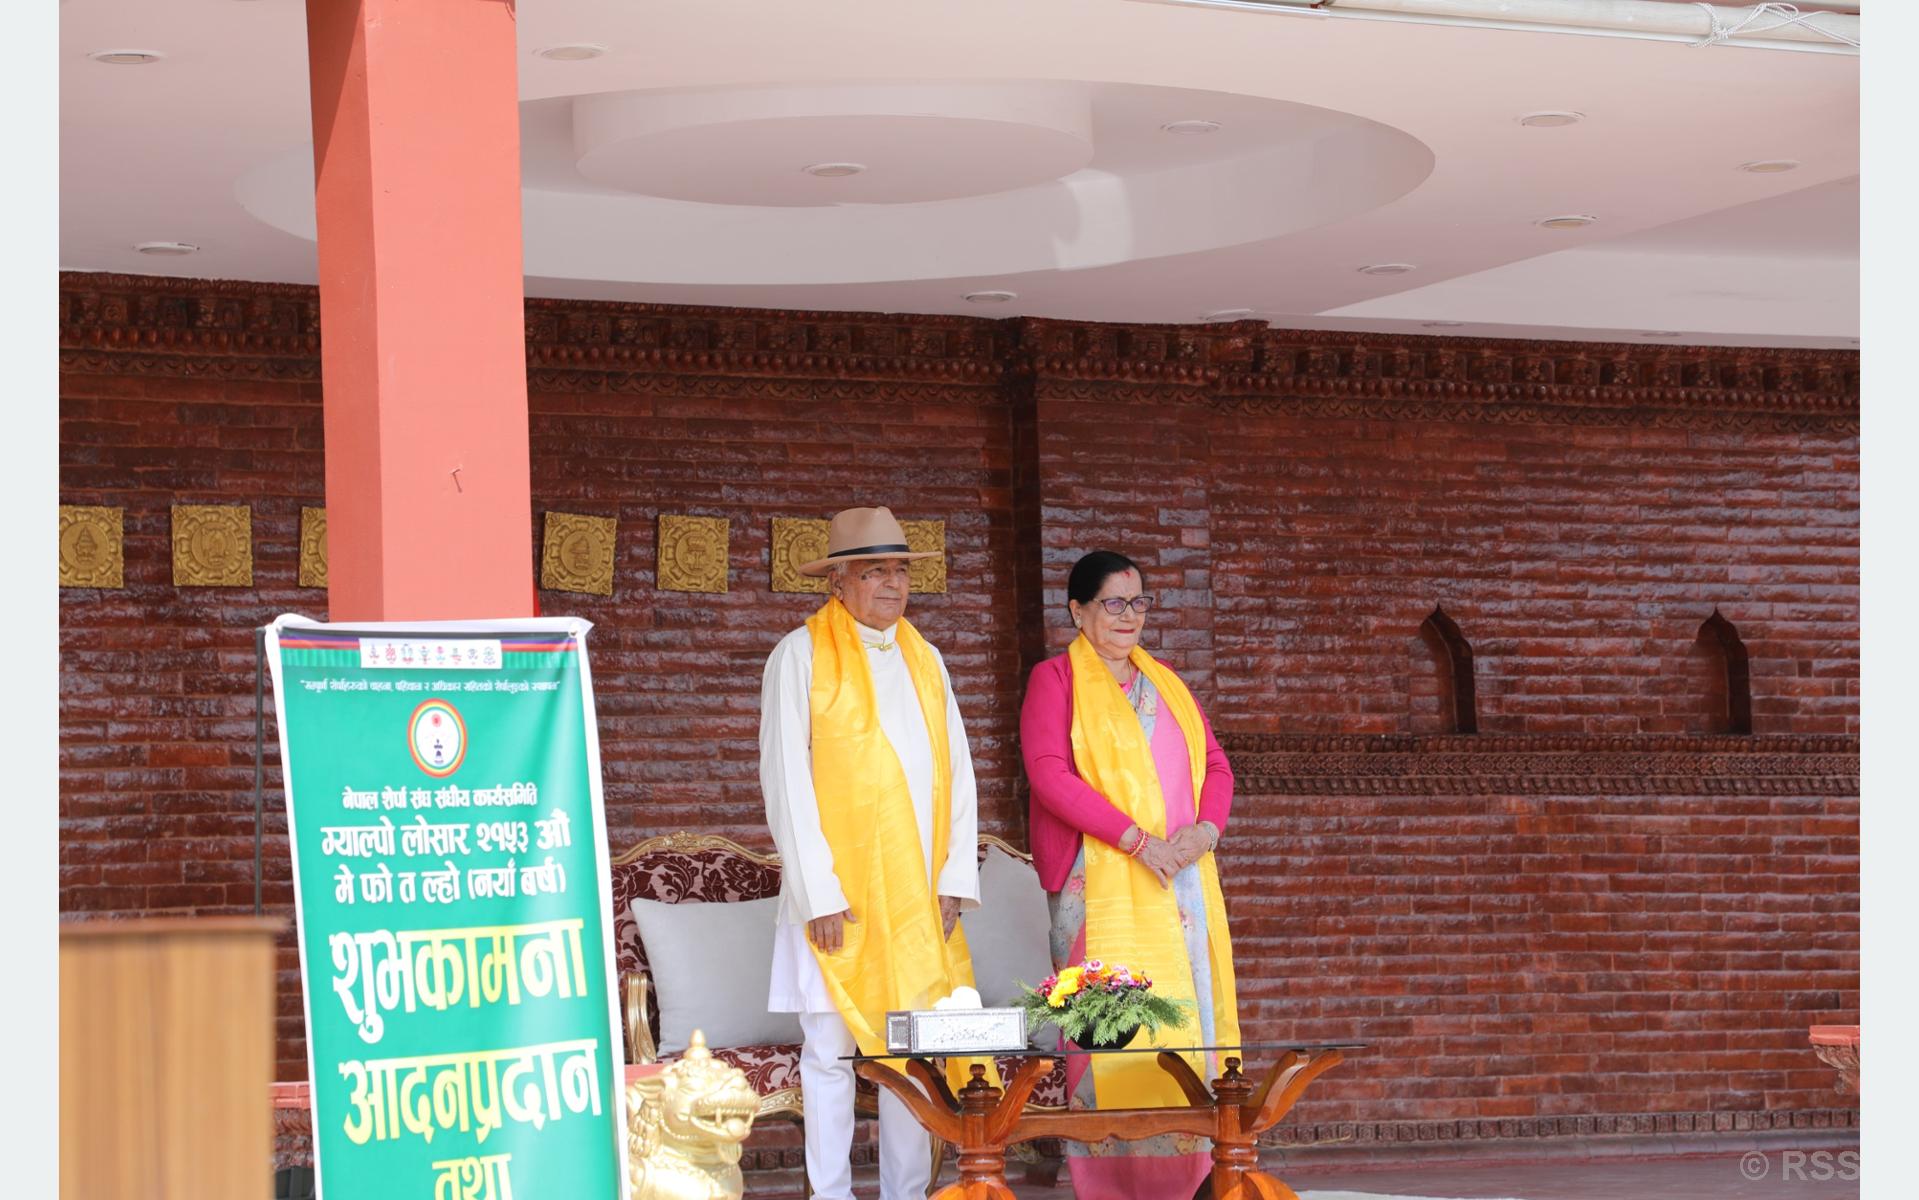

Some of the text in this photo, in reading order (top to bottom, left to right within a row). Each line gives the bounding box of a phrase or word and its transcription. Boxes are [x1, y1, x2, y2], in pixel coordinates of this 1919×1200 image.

[424, 681, 430, 691] र
[342, 785, 378, 810] नेपाल
[472, 781, 538, 807] कार्यसमिति
[320, 815, 395, 858] ग्याल्पो
[400, 814, 470, 857] लोसार
[476, 820, 529, 854] २१५३
[334, 863, 355, 904] मे
[360, 862, 393, 904] फो
[398, 872, 416, 904] त
[421, 860, 461, 904] ल्हो
[328, 918, 587, 1044] शुभकामना
[338, 1038, 602, 1145] आदनप्रदान
[431, 1153, 513, 1200] तथा
